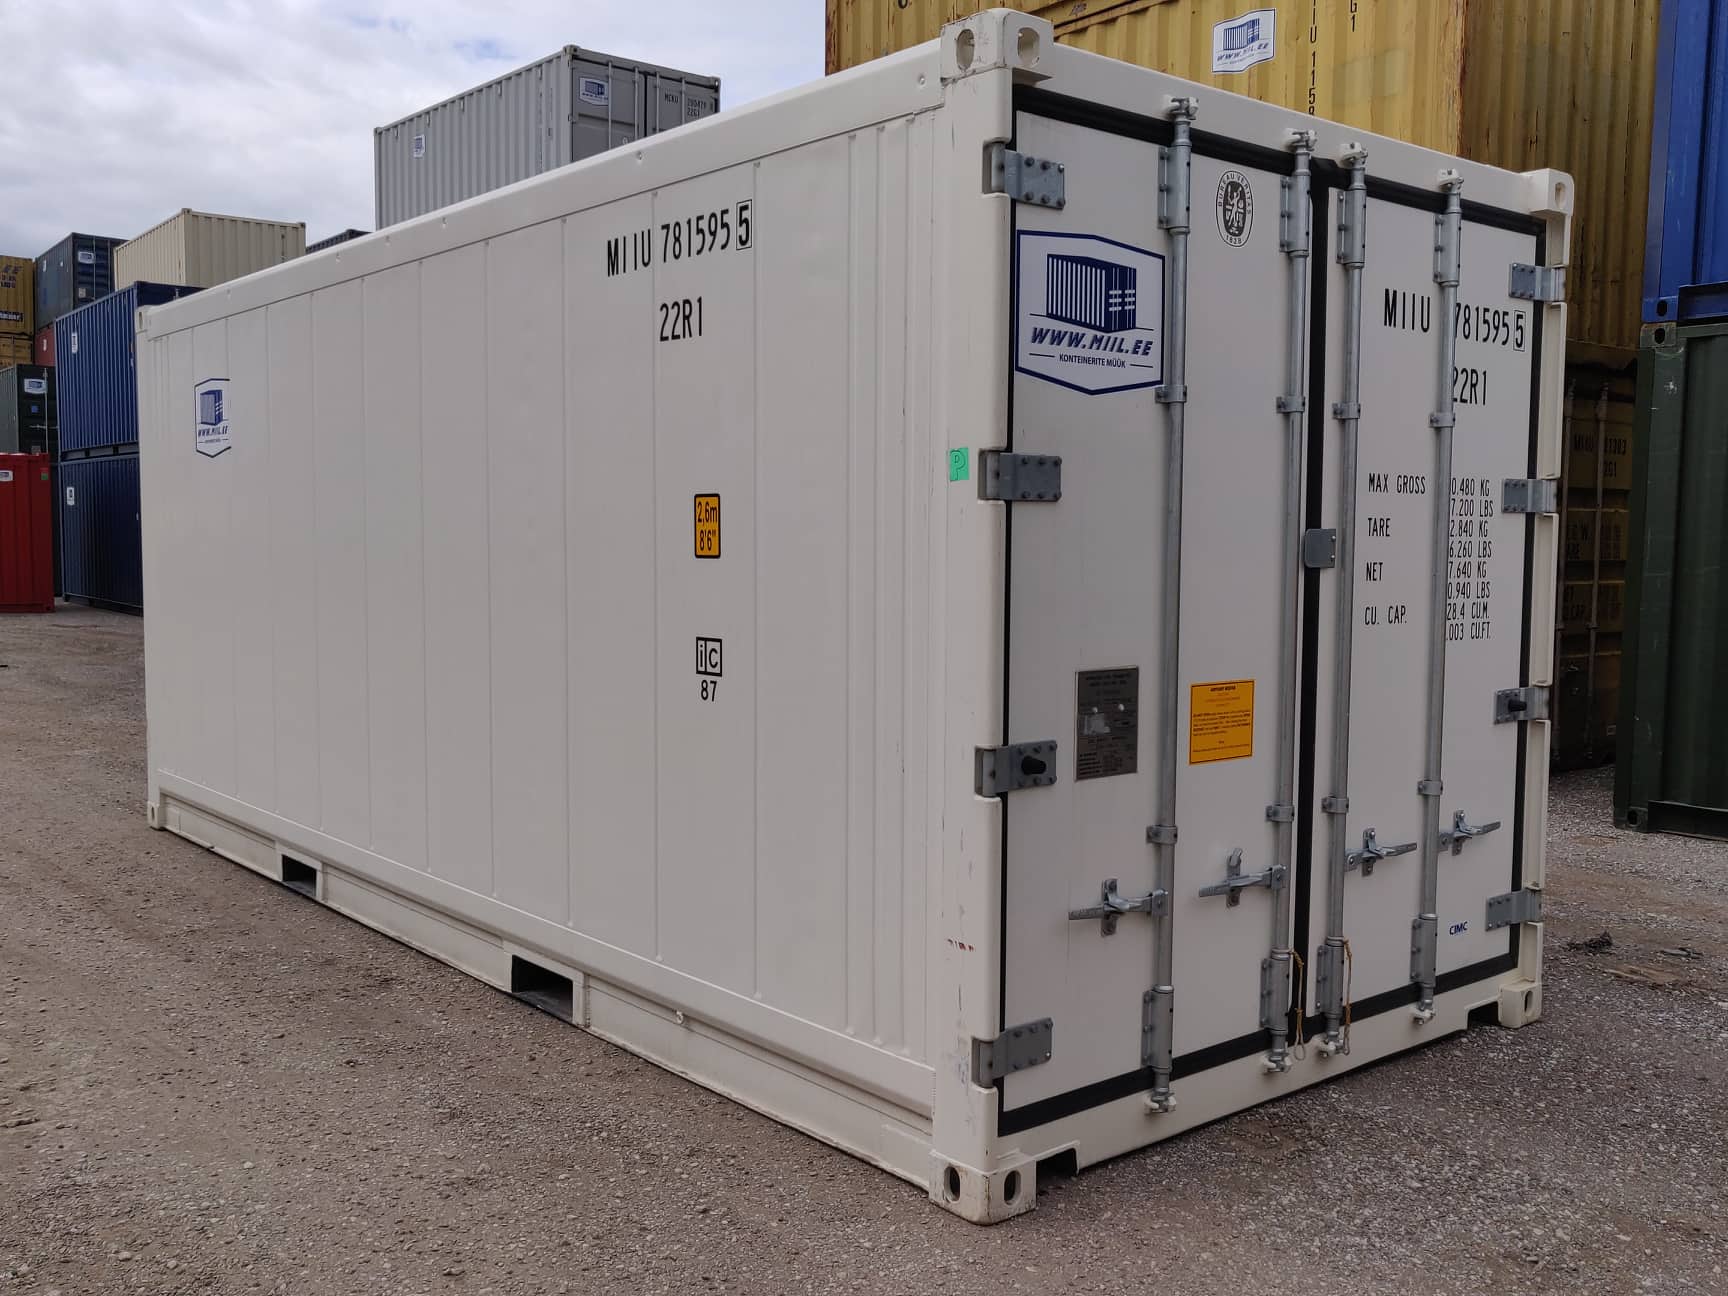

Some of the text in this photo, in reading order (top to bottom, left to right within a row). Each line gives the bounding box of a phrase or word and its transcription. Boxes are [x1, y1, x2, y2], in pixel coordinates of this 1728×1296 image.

[606, 229, 652, 278] MIIU
[659, 296, 703, 342] 22R1
[1383, 288, 1431, 333] MIIU
[1030, 325, 1154, 357] WWW.MIIL.EE
[1059, 352, 1126, 369] KONTEINERITE MÜÜK
[1368, 473, 1490, 497] MAX GROSS 0.480 KG
[1479, 500, 1494, 518] LBS
[1367, 517, 1489, 538] TARE 2.840 KG
[1477, 541, 1492, 559] LBS
[1366, 562, 1384, 582] NET
[1477, 561, 1487, 579] KG
[1476, 581, 1491, 599] LBS
[1364, 606, 1380, 626] CU.
[1387, 605, 1408, 625] CAP.
[1446, 602, 1465, 620] 28.4
[1446, 623, 1464, 641] .003
[700, 679, 717, 702] 87
[1449, 921, 1468, 936] CIMC
